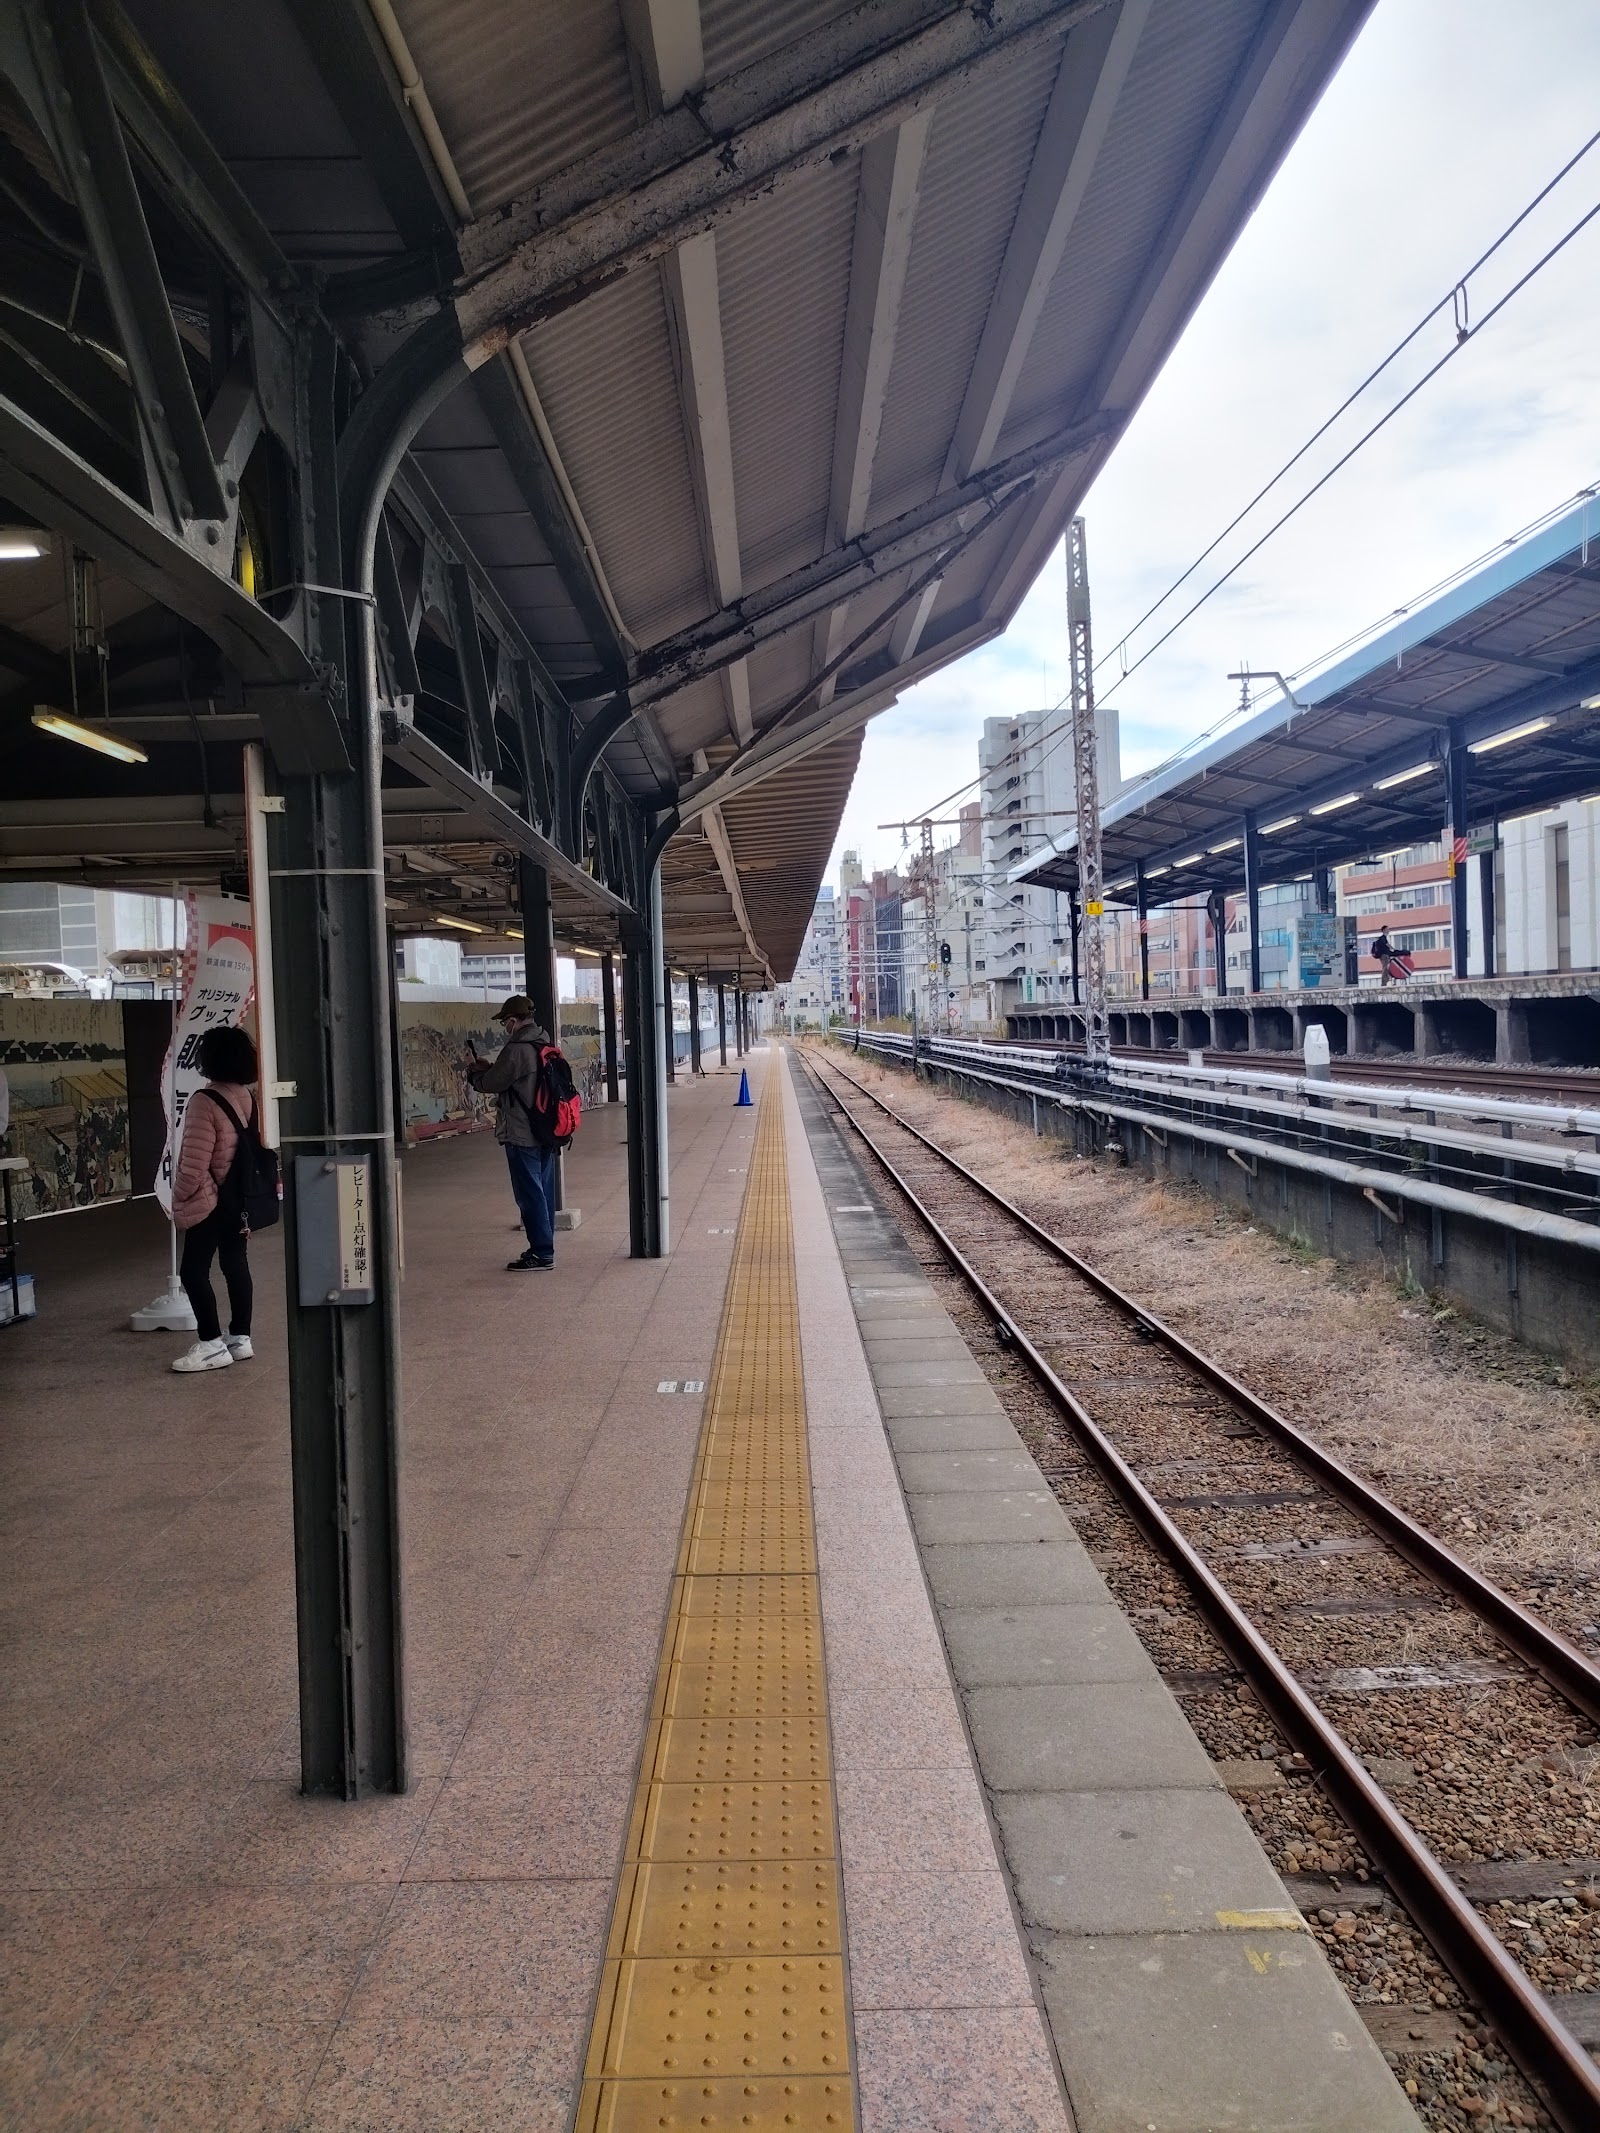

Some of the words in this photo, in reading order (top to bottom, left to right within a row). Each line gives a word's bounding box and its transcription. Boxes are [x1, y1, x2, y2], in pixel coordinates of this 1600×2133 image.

[198, 988, 240, 1003] オリジナル
[189, 1005, 235, 1024] グッズ
